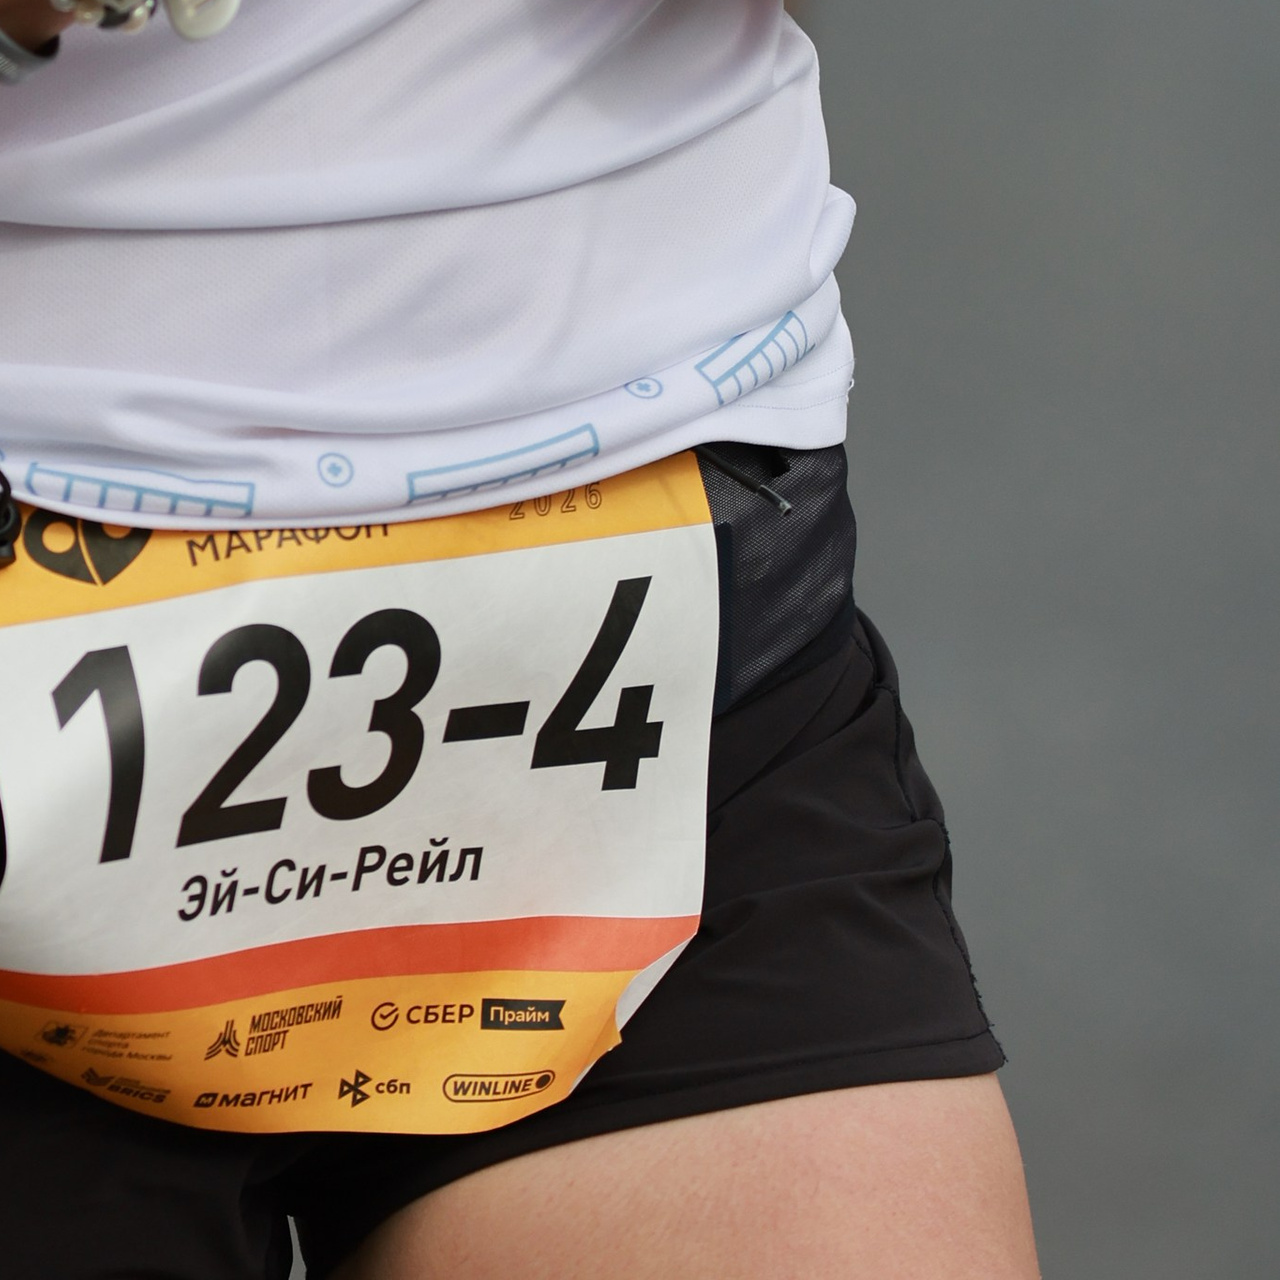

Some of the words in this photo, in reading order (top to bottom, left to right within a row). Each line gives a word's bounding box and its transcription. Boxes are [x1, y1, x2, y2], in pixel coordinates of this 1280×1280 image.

[508, 481, 602, 520] 2026
[51, 575, 664, 865] 123-4
[177, 836, 484, 922] Эй-Си-Рейл
[248, 995, 343, 1035] МОСКОВСКИЙ
[406, 1003, 475, 1025] СБЕР
[489, 1006, 550, 1026] Прайм
[244, 1028, 289, 1058] СПОРТ
[107, 1084, 166, 1103] BRICS
[375, 1078, 411, 1095] сбп
[452, 1077, 534, 1097] WINLINE
